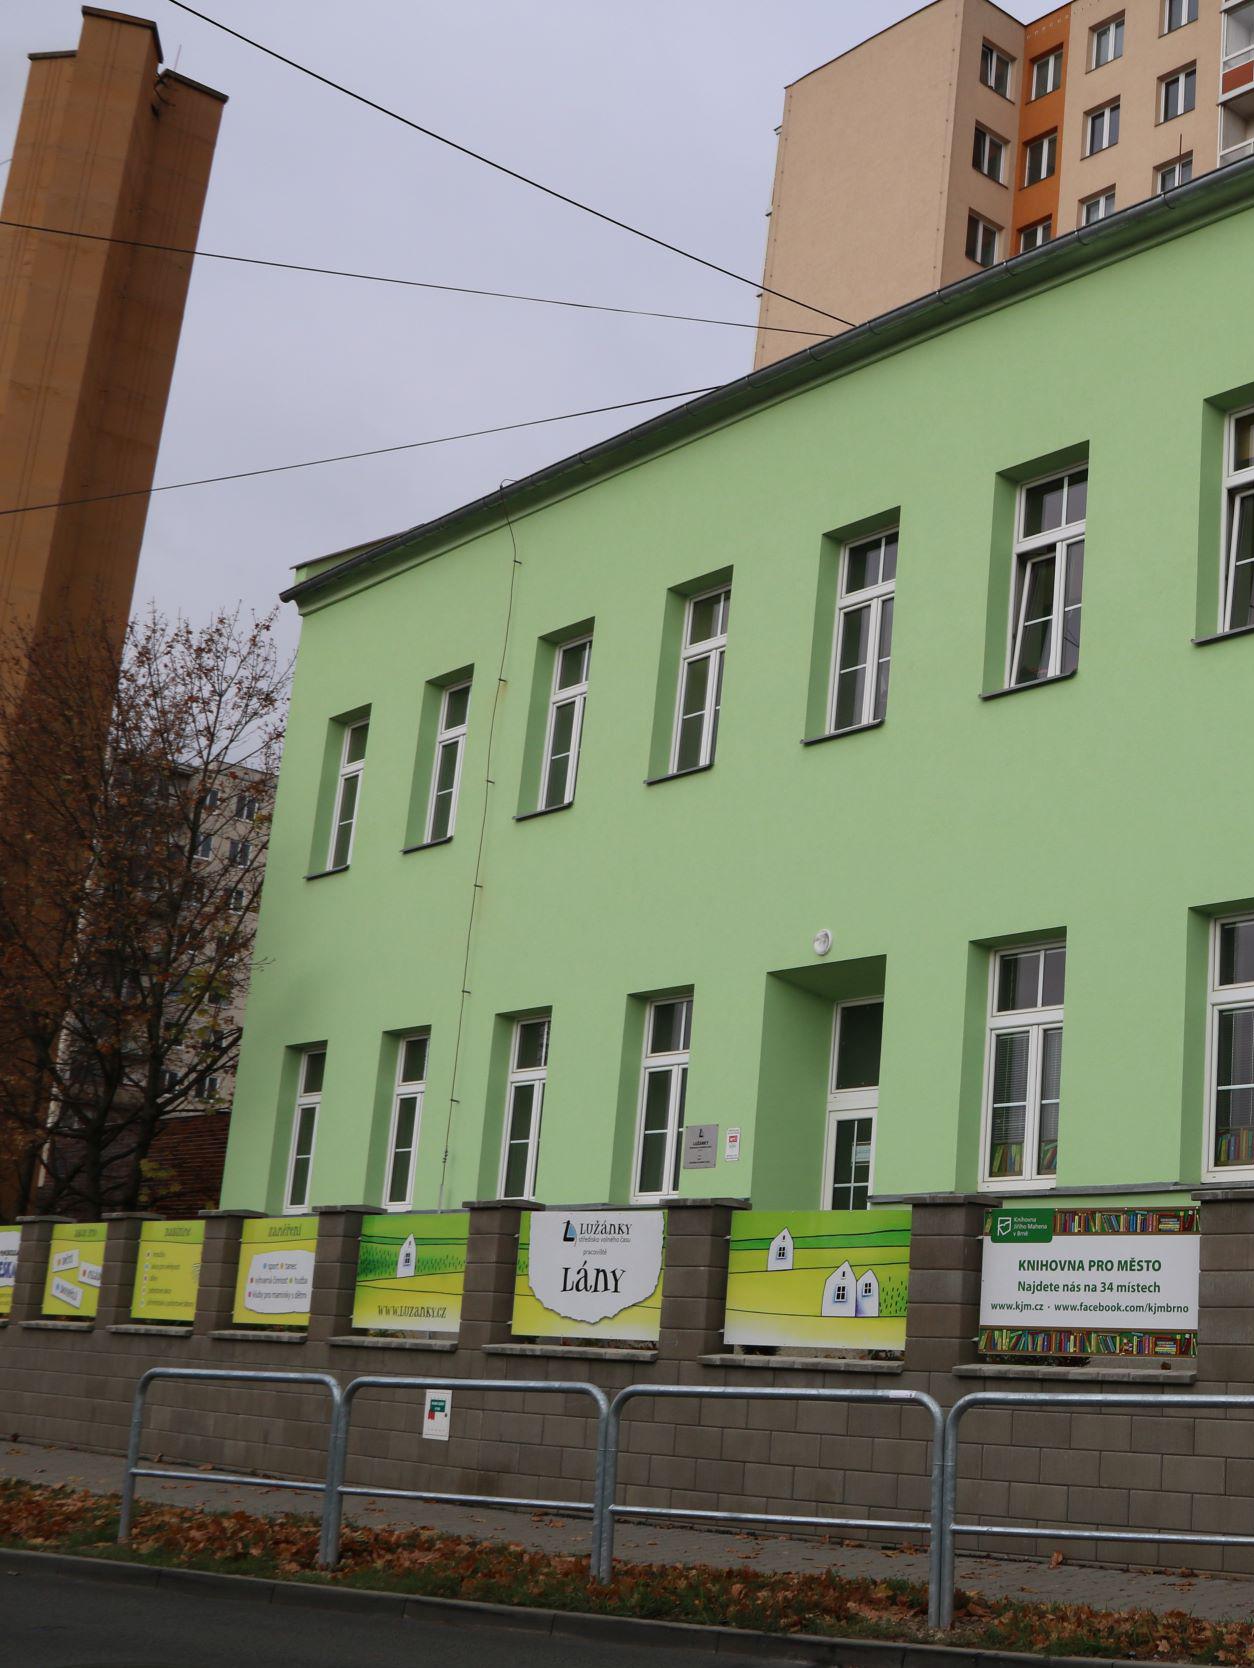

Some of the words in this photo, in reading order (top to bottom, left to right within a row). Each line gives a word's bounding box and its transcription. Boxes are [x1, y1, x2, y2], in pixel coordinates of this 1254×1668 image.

[1018, 1259, 1085, 1271] KNIHOVNA
[1088, 1259, 1114, 1271] PRO
[1117, 1257, 1162, 1272] MĚSTO
[1017, 1281, 1060, 1294] Najdete
[1062, 1281, 1081, 1292] nás
[1084, 1283, 1098, 1292] na
[1100, 1281, 1114, 1293] 34
[1116, 1281, 1161, 1293] místech
[991, 1301, 1044, 1312] www.kjm.cz
[1054, 1301, 1189, 1315] www.facebook.com/kjmbrno
